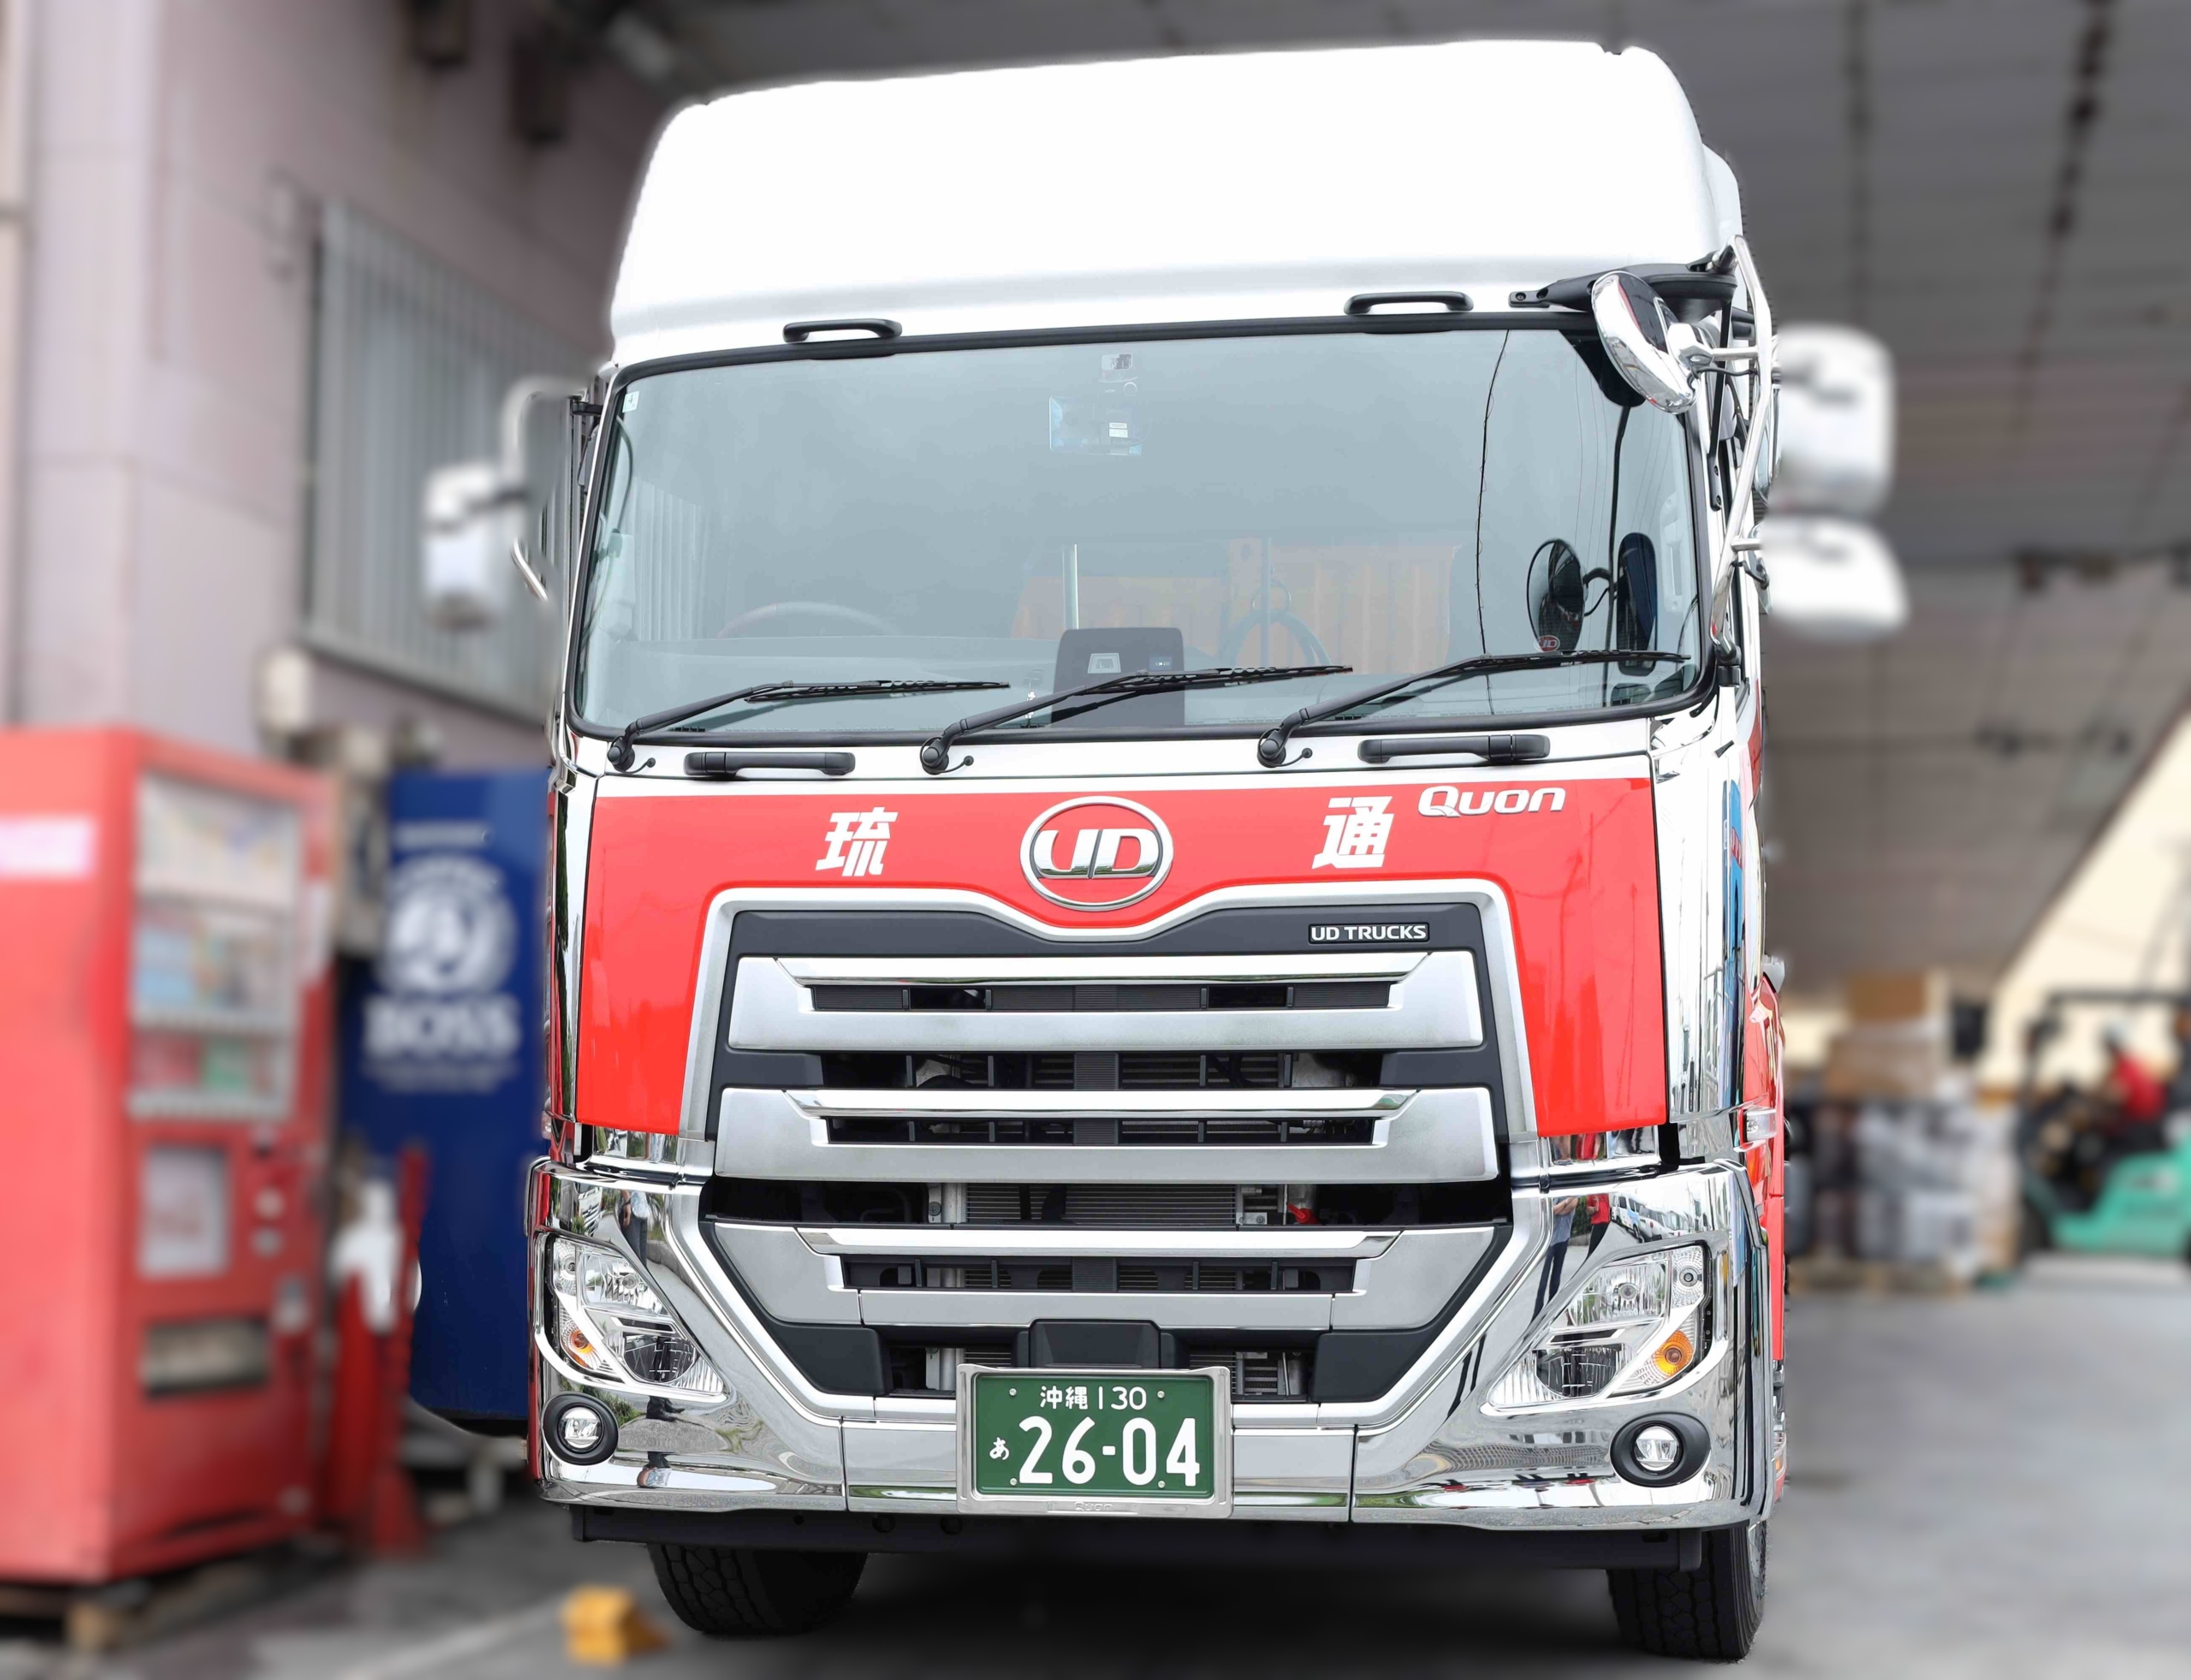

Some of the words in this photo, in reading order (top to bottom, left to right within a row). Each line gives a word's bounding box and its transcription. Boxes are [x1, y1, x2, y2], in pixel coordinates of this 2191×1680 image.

[816, 806, 899, 877] 琉
[1033, 828, 1158, 880] UD
[1311, 796, 1395, 870] 通
[1311, 926, 1339, 941] UD
[1344, 924, 1427, 941] TRUCKS
[1040, 1386, 1089, 1410] 沖縄
[1098, 1386, 1147, 1410] 130
[989, 1437, 1010, 1460] あ
[1018, 1416, 1201, 1487] 26-04
